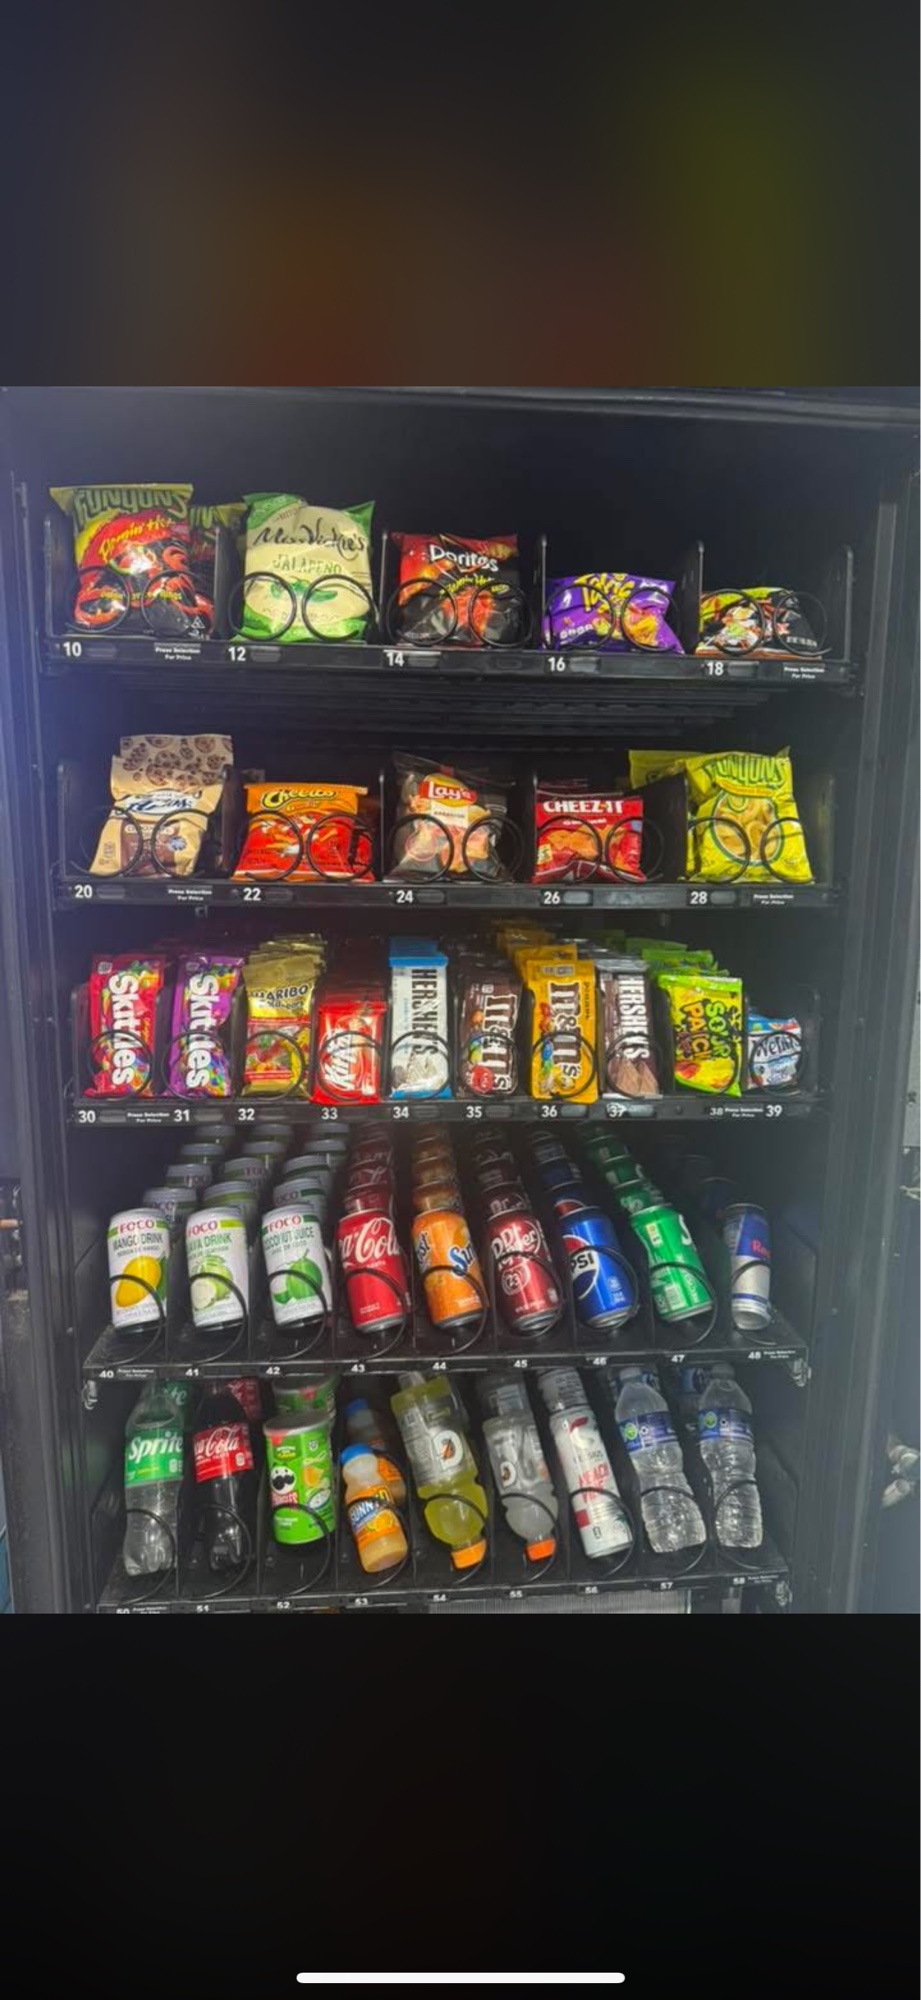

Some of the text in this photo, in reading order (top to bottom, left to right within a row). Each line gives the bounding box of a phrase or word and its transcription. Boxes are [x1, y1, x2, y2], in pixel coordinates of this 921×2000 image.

[428, 543, 500, 573] Doritos
[63, 641, 83, 657] 10
[228, 646, 247, 662] 12
[386, 652, 405, 667] 14
[547, 657, 566, 672] 16
[707, 661, 724, 676] 18
[704, 754, 786, 787] FUNYUNS
[428, 781, 473, 799] Lay's
[262, 787, 339, 811] Cheetos
[74, 884, 93, 899] 20
[243, 887, 261, 901] 22
[396, 889, 414, 904] 24
[543, 891, 561, 905] 26
[690, 891, 708, 905] 28
[78, 1110, 96, 1123] 30
[173, 1109, 191, 1122] 31
[237, 1108, 256, 1121] 32
[321, 1107, 338, 1120] 33
[393, 1106, 410, 1119] 34
[466, 1105, 483, 1118] 35
[541, 1105, 558, 1118] 36
[608, 1105, 624, 1118] 37
[710, 1107, 724, 1117] 38
[765, 1105, 783, 1118] 39
[119, 1219, 155, 1235] FOCO
[593, 1357, 607, 1366] 46
[671, 1354, 685, 1363] 47
[748, 1351, 761, 1360] 48
[351, 1364, 365, 1373] 43
[433, 1362, 447, 1371] 44
[513, 1359, 528, 1369] 45
[100, 1370, 114, 1379] 40
[186, 1368, 199, 1377] 41
[266, 1366, 281, 1376] 42
[128, 1430, 183, 1464] Sprite
[660, 1582, 674, 1590] 57
[733, 1577, 745, 1585] 58
[510, 1590, 523, 1598] 55
[585, 1586, 598, 1595] 56
[355, 1598, 368, 1606] 53
[433, 1594, 447, 1602] 54
[196, 1605, 209, 1613] 51
[277, 1601, 290, 1610] 52
